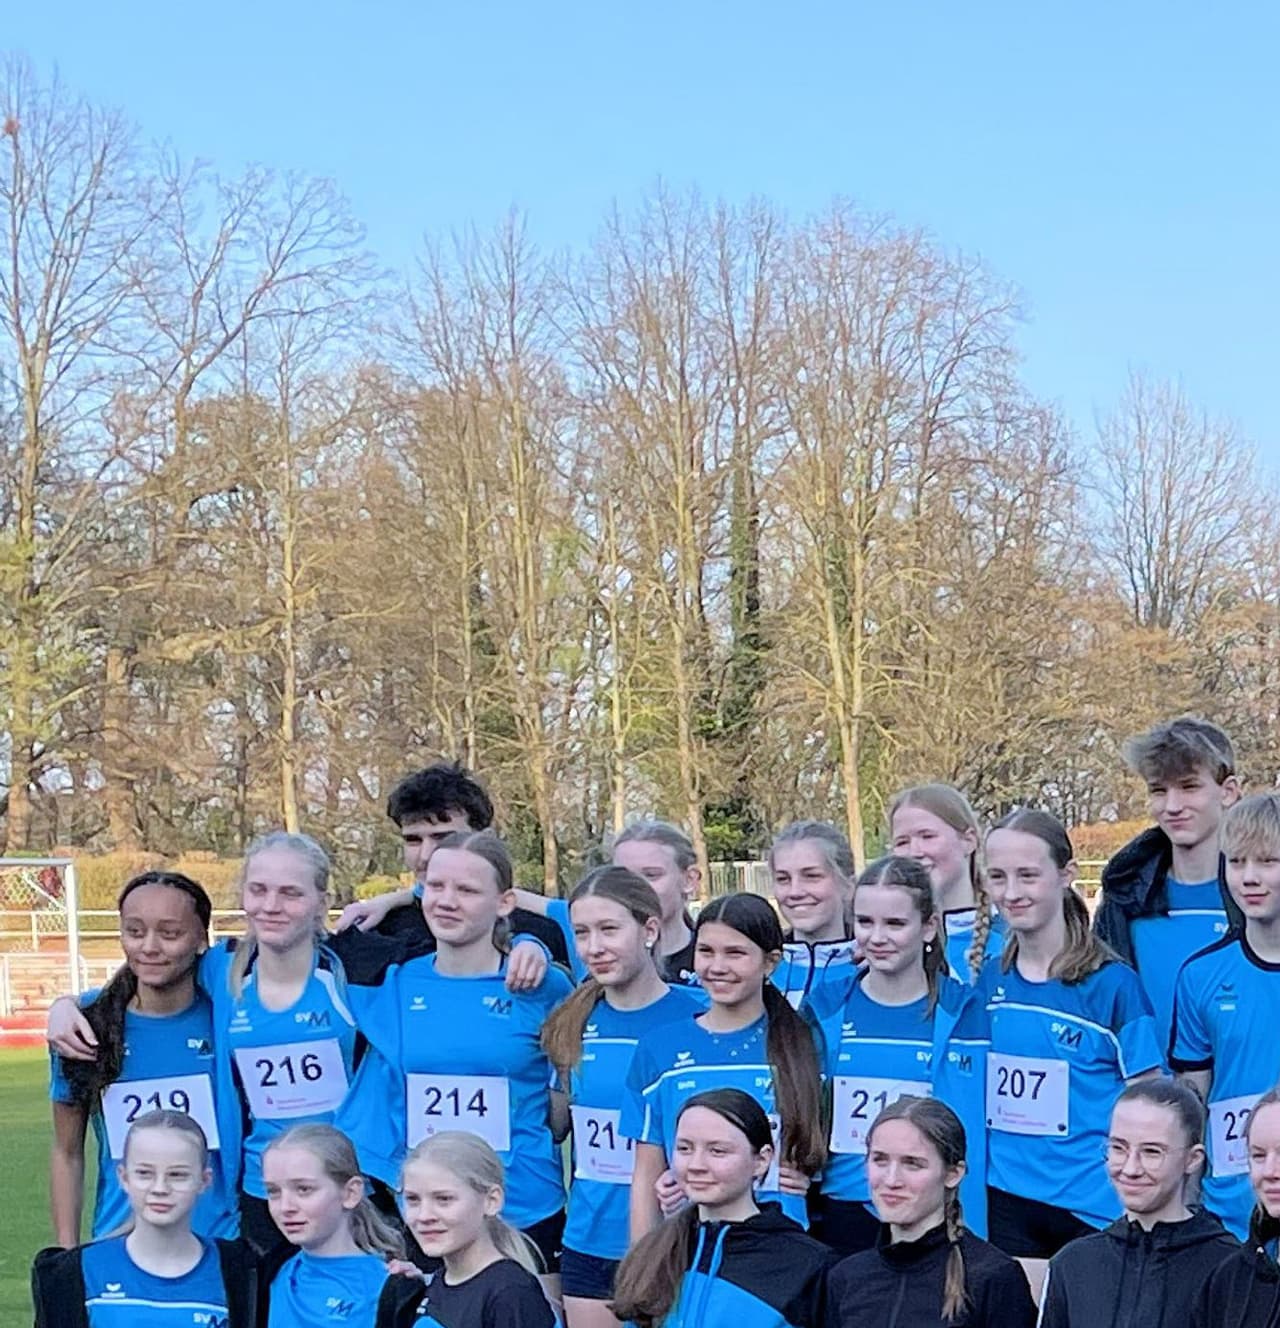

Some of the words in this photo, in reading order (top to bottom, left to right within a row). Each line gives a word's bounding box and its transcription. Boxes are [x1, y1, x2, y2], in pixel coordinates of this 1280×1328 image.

[256, 1053, 322, 1087] 216
[996, 1066, 1047, 1100] 207
[424, 1086, 488, 1117] 214
[850, 1089, 890, 1120] 21
